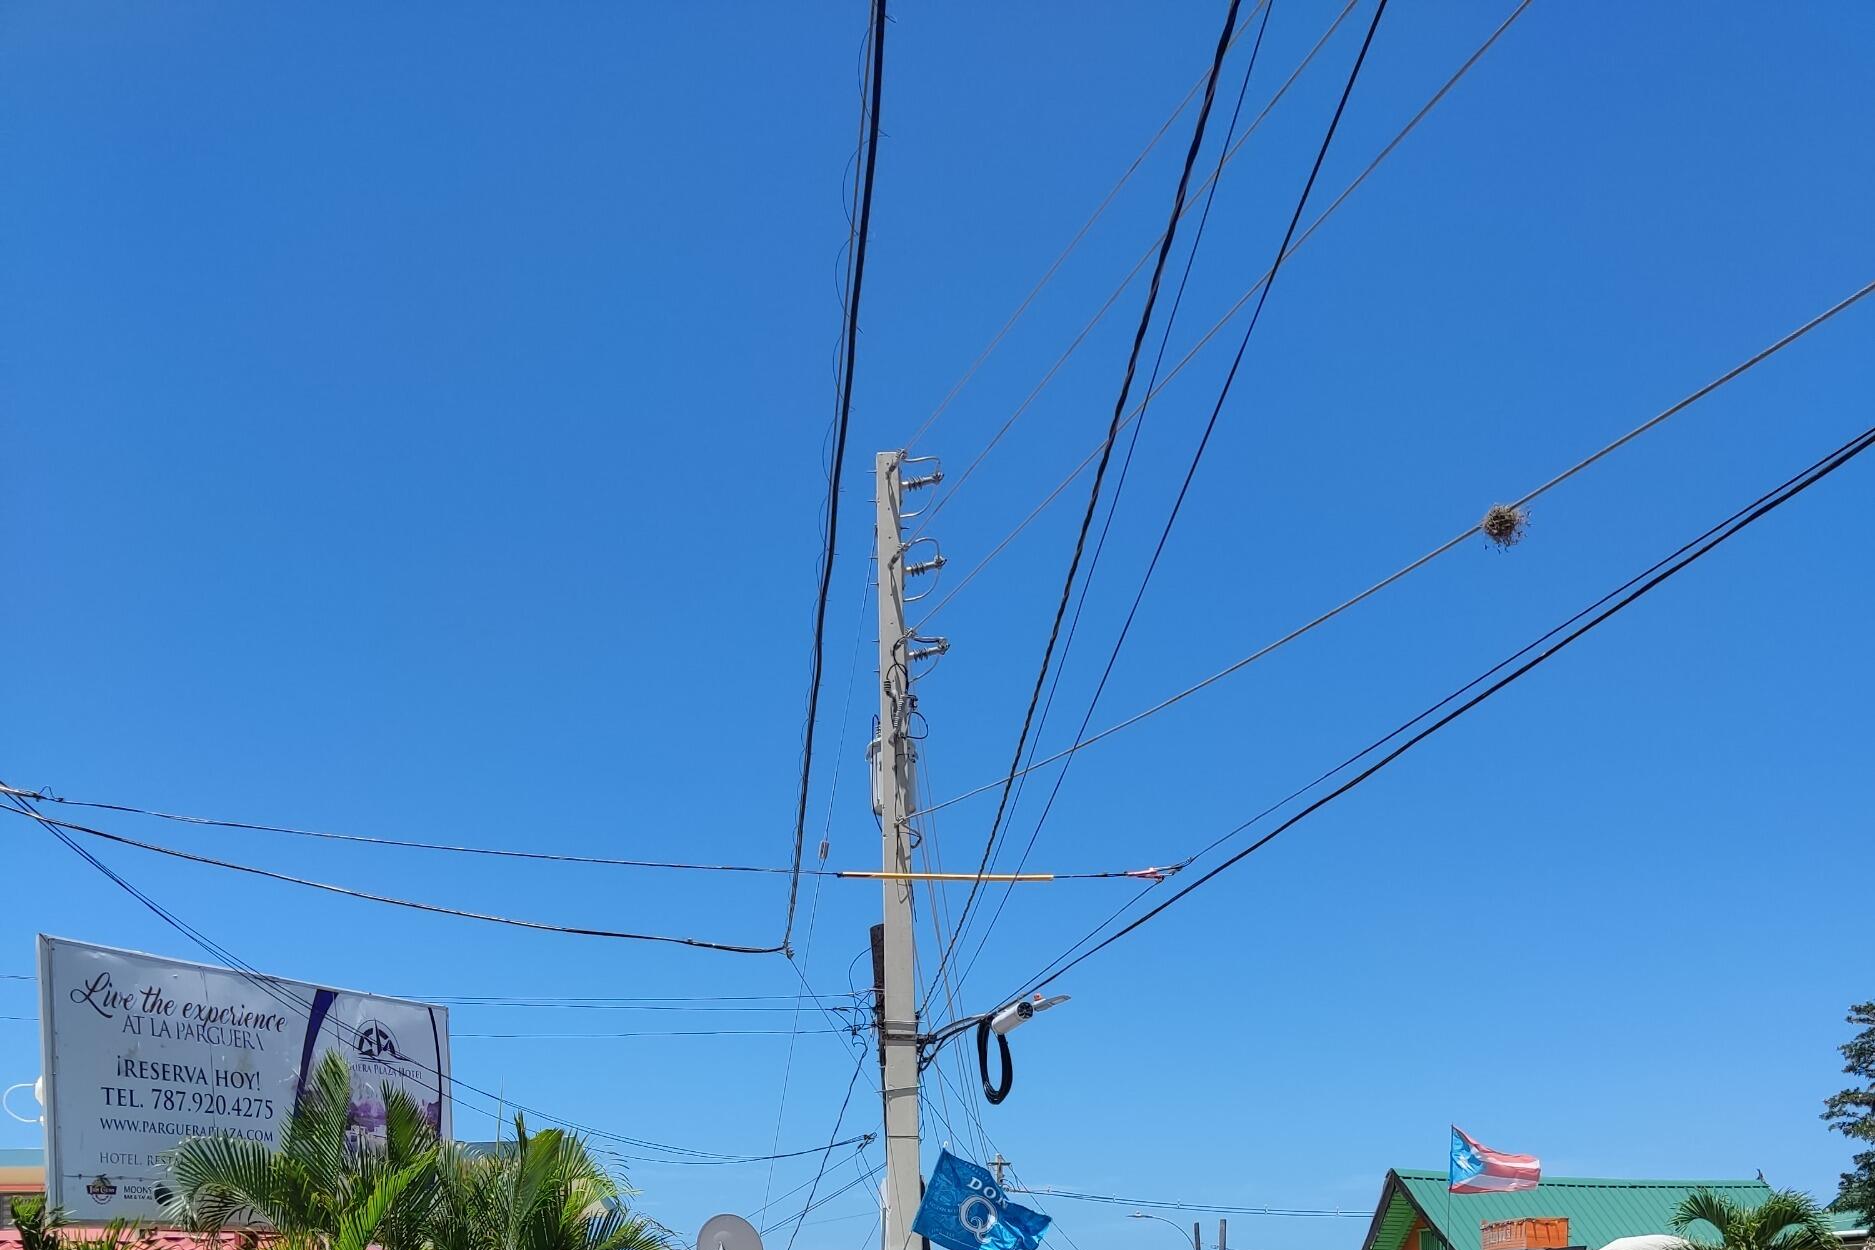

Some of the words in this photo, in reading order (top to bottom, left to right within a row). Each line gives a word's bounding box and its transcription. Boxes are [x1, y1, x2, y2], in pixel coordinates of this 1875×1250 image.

[70, 972, 134, 1018] Live
[141, 986, 174, 1016] the
[183, 1003, 286, 1033] experience
[122, 1015, 144, 1034] AT
[151, 1018, 171, 1039] LA
[216, 1070, 261, 1091] HOY!
[101, 1087, 143, 1108] TEL.
[151, 1089, 273, 1119] 787.920.4275
[959, 1195, 997, 1244] Q
